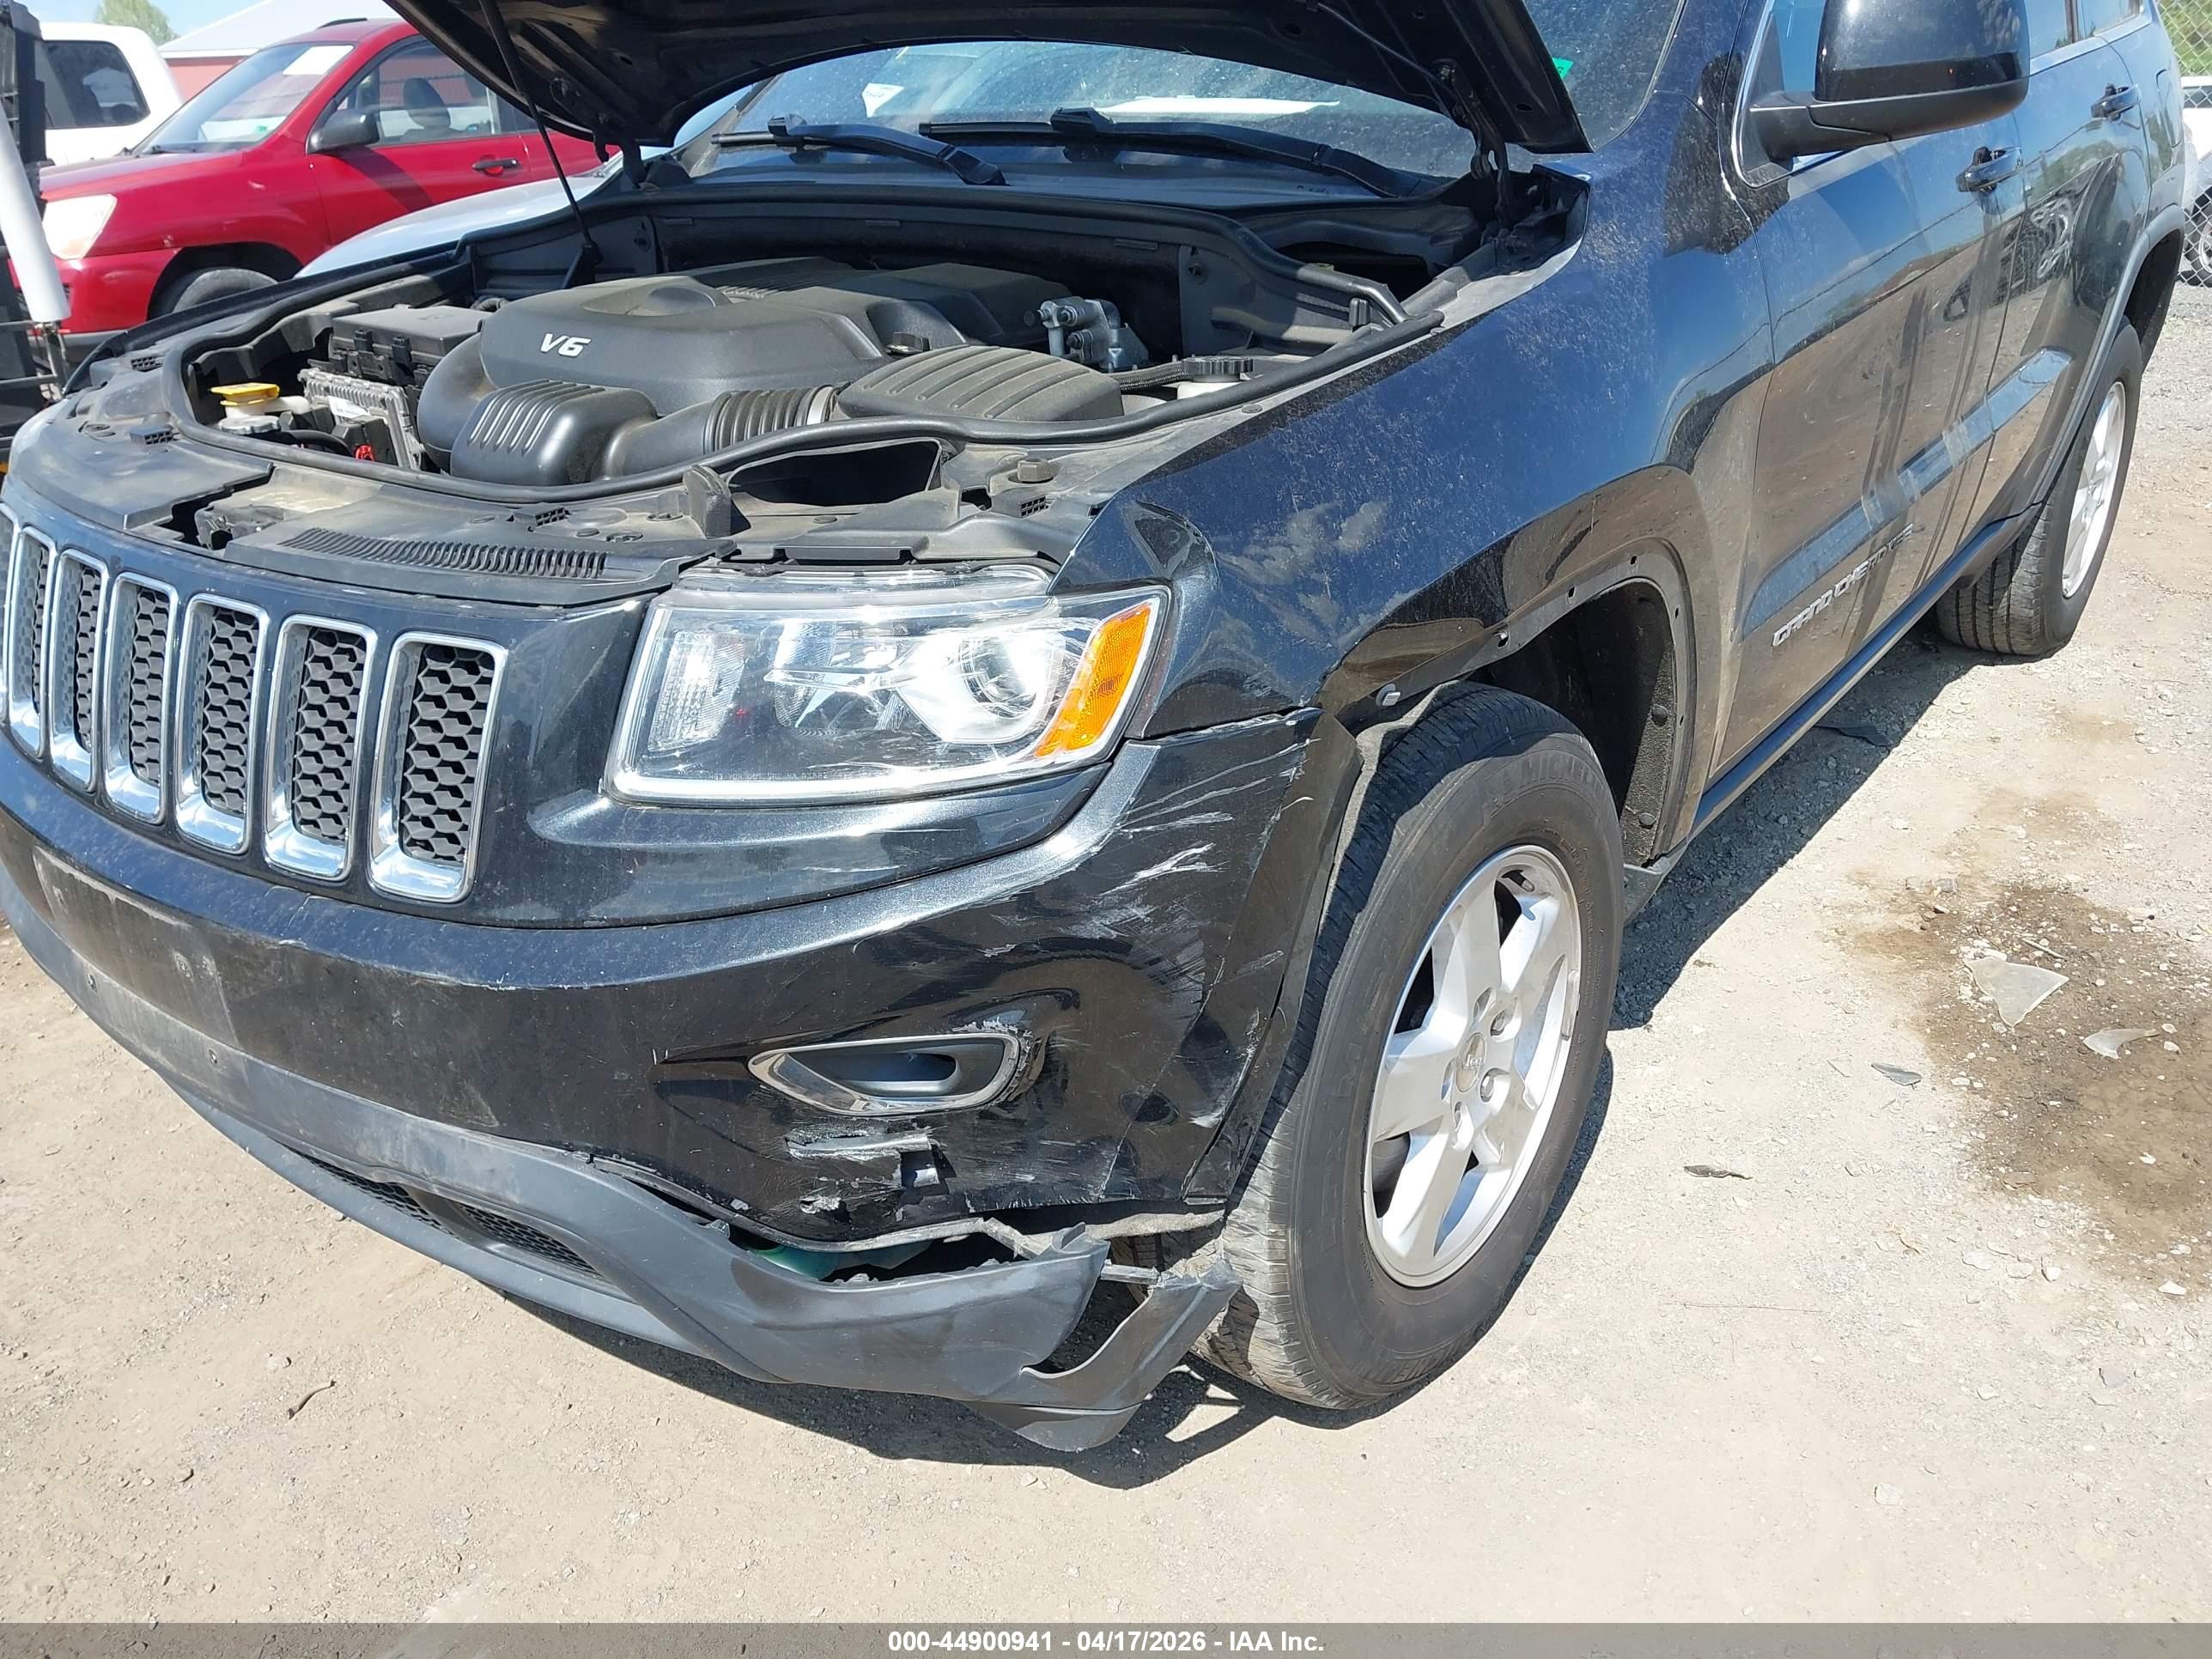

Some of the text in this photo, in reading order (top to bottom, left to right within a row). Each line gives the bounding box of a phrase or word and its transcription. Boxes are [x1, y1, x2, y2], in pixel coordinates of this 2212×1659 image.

[540, 332, 592, 357] V6
[1771, 522, 1914, 647] GRAND CHEROKEE
